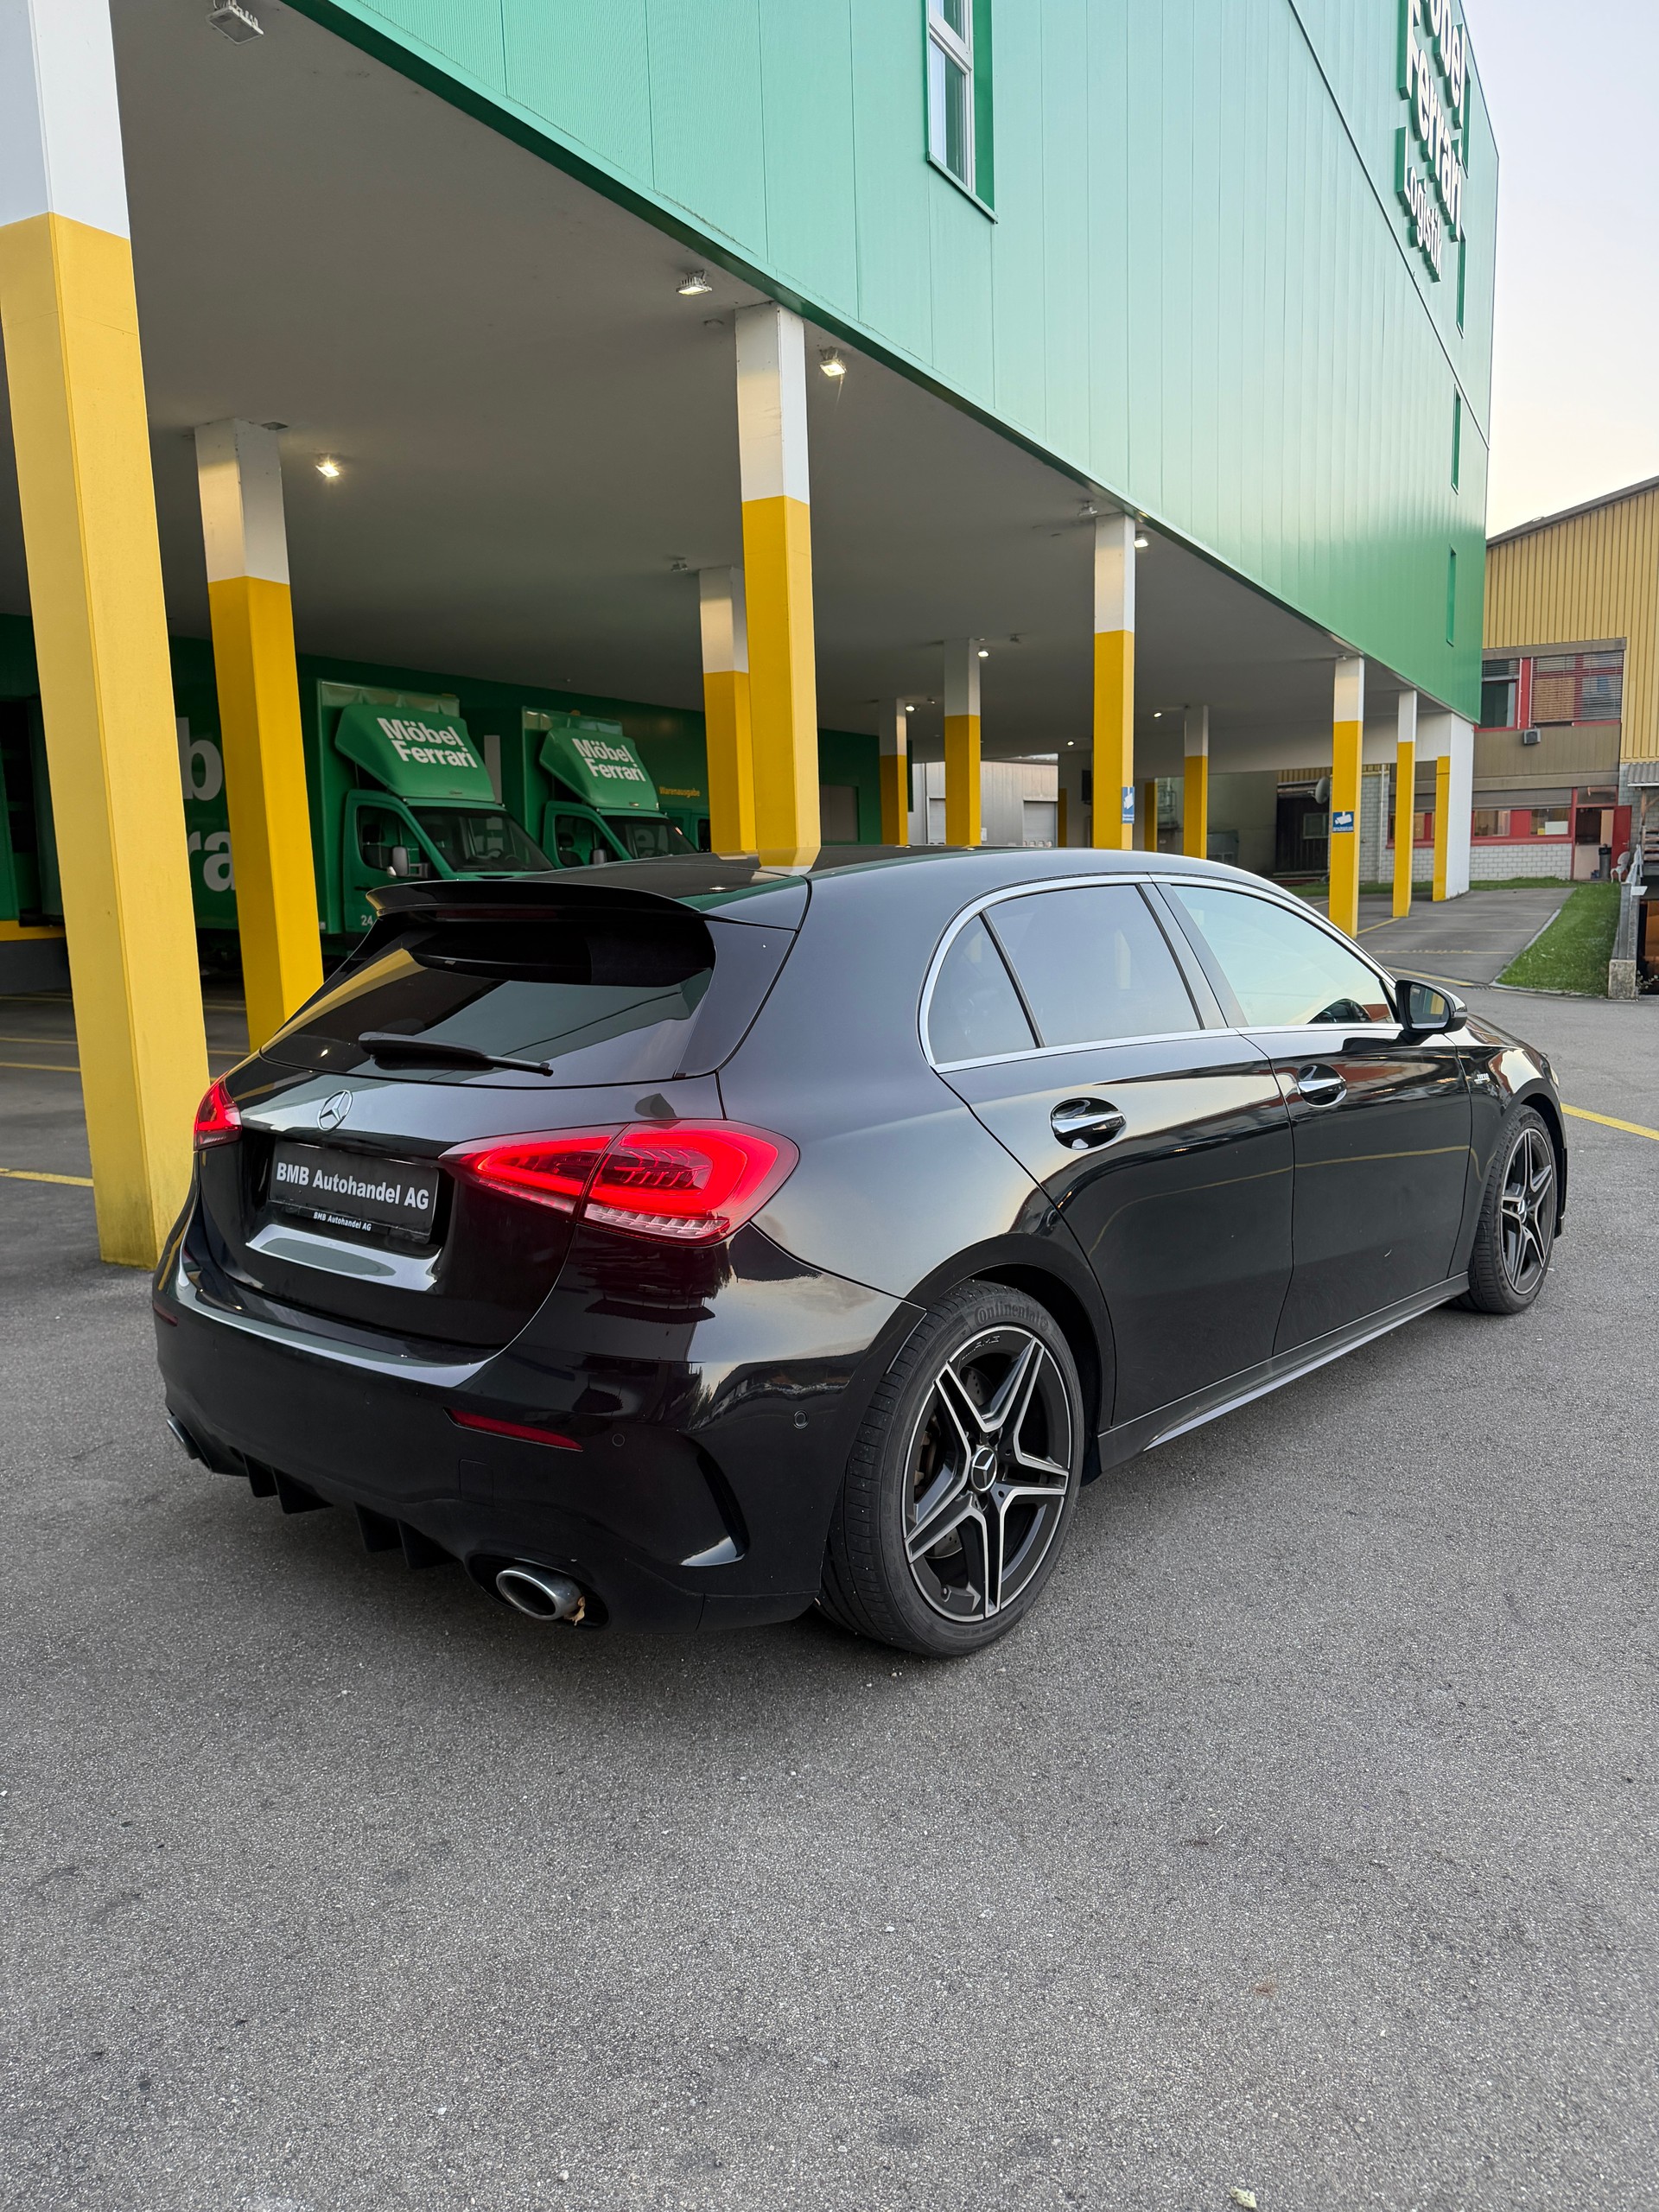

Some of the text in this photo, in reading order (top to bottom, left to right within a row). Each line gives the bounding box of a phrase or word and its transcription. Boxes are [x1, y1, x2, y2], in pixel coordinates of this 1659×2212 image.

[1406, 0, 1463, 242] Ferrari
[1404, 127, 1442, 282] Logistik
[377, 717, 464, 747] Möbel
[391, 740, 478, 768] Ferrari
[572, 738, 635, 763] Möbel
[584, 758, 646, 782] Ferrari
[360, 915, 373, 926] 24
[276, 1162, 429, 1211] BMB Autohandel AG
[313, 1211, 372, 1231] BMB Autohandel AG
[974, 1301, 1040, 1327] Continental
